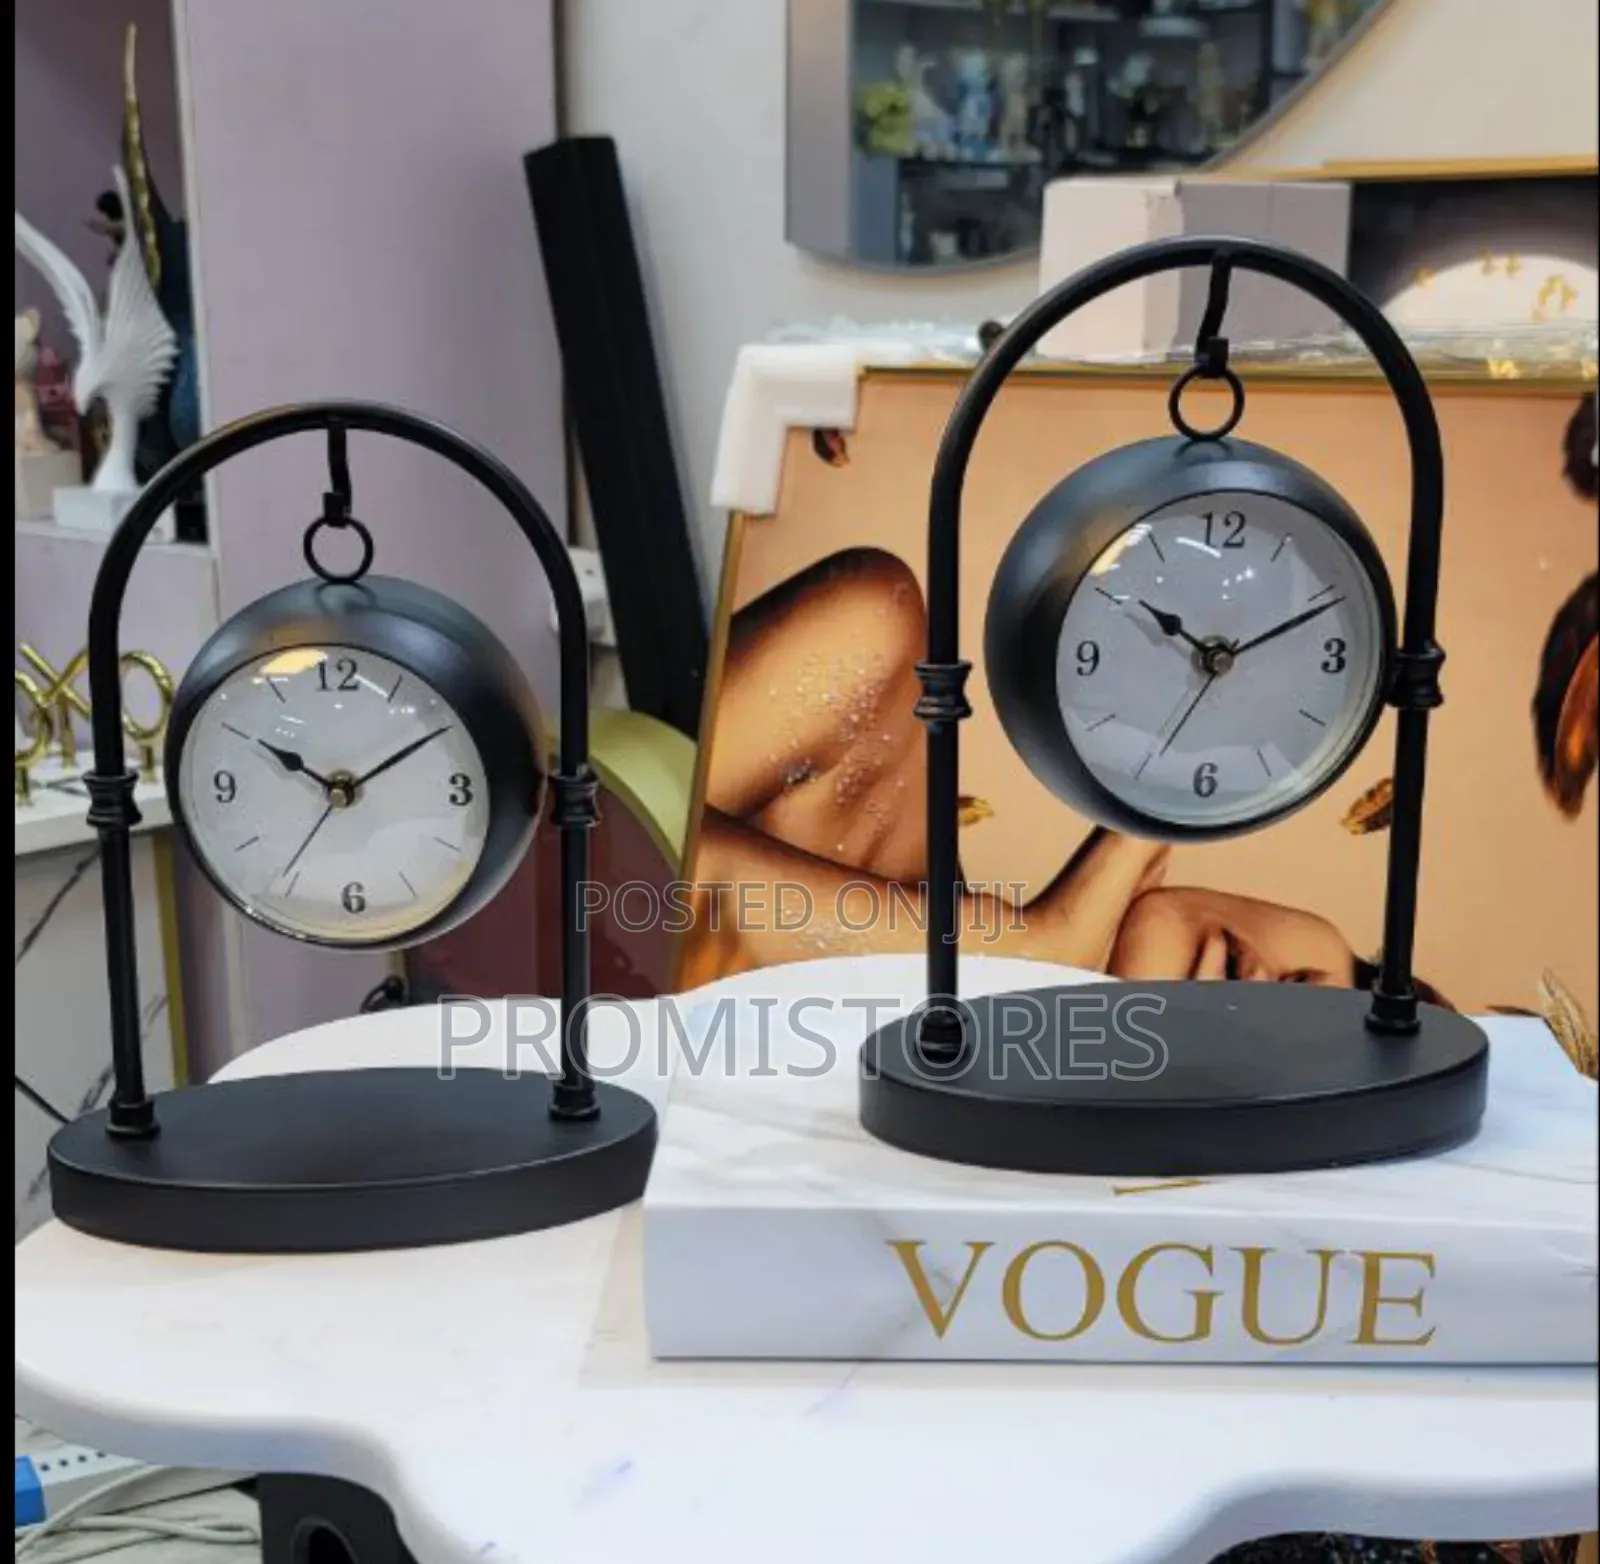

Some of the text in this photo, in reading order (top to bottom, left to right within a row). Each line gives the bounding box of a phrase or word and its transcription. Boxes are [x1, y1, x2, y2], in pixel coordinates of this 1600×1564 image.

[1202, 511, 1246, 549] 12
[1076, 637, 1346, 676] 9 3
[315, 658, 360, 692] 12
[213, 770, 473, 806] 9 3
[1193, 762, 1218, 797] 6
[341, 882, 366, 913] 6
[884, 1238, 1437, 1346] VOGUE
